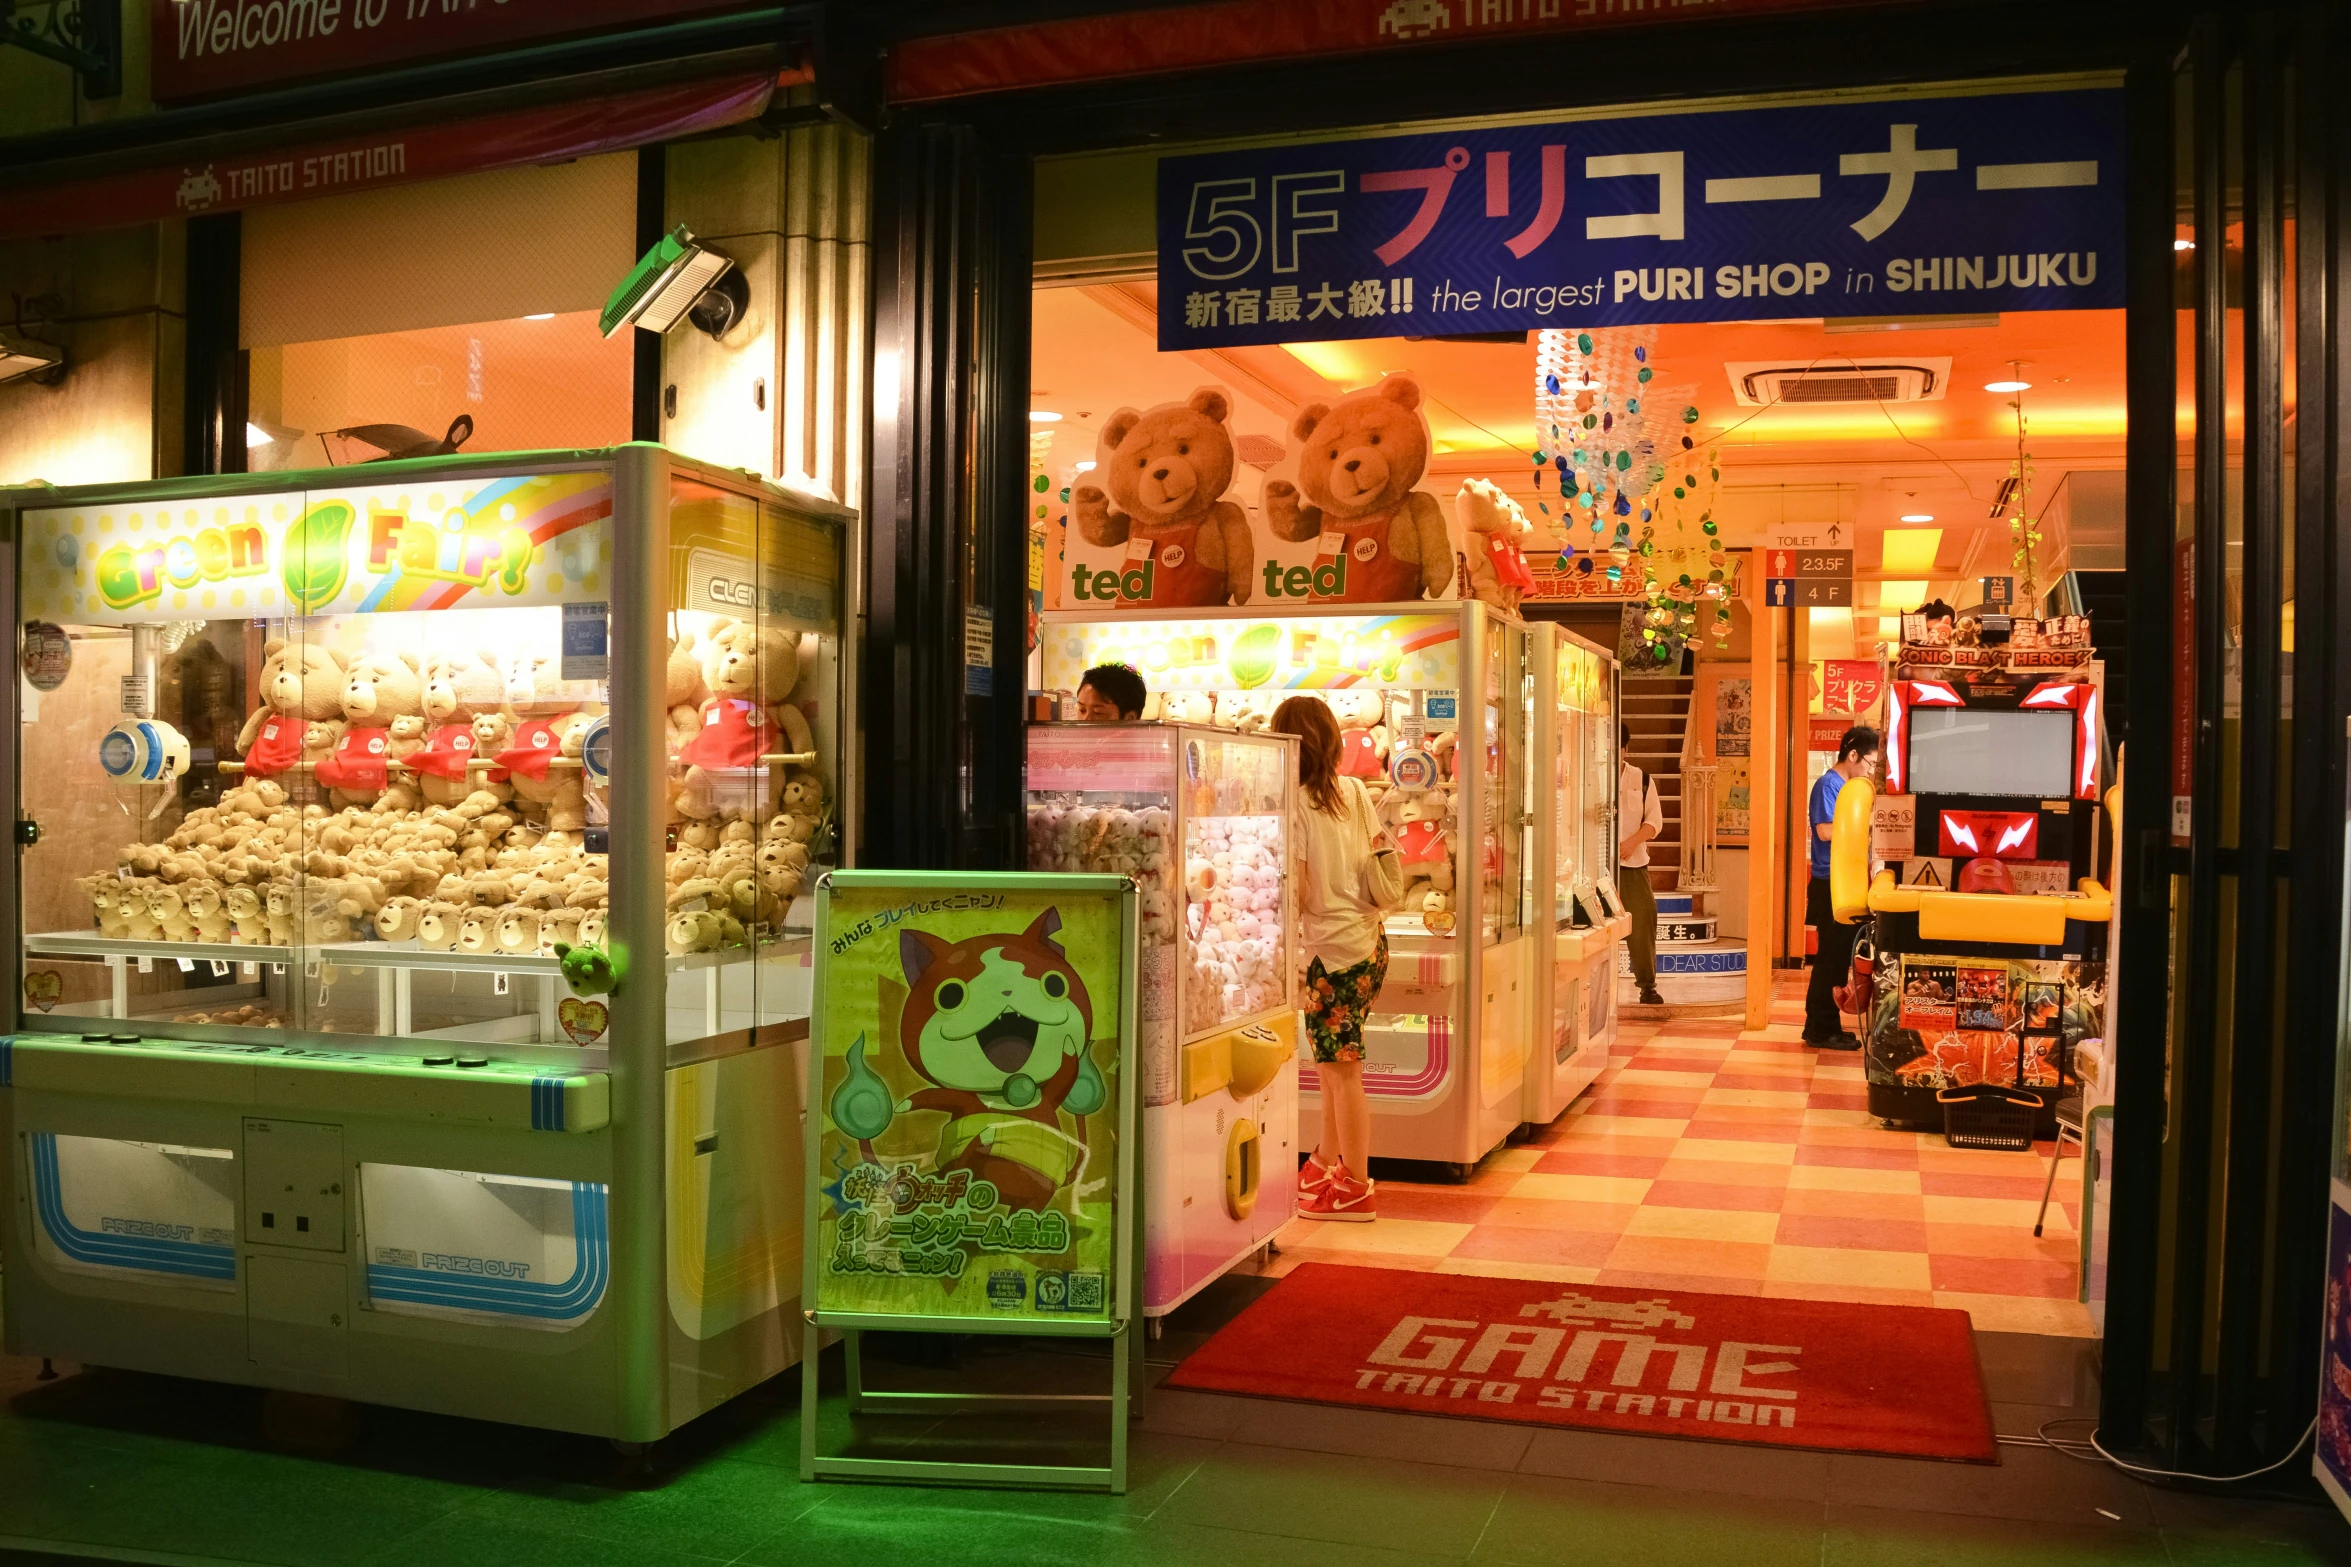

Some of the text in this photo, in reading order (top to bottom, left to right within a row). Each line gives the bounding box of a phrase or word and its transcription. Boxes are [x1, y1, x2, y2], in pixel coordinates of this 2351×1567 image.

[178, 0, 340, 60] Welcome
[354, 0, 388, 30] to
[227, 143, 406, 199] TAITO STATION
[1184, 251, 2097, 329] 新宿最大級!! the largest PURI SHOP in SHINJUKU
[1356, 543, 1376, 557] HELP
[1777, 536, 1818, 546] TOILET
[97, 507, 532, 608] Green Fair!
[1164, 550, 1183, 563] HELP
[1802, 557, 1845, 571] 2.3.5F
[1071, 559, 1155, 601] ted
[1262, 553, 1347, 597] ted
[1827, 664, 1844, 677] 5F
[1898, 648, 2092, 672] SONIC BLAST HEROES
[1814, 730, 1842, 740] PRIZE
[1662, 955, 1706, 972] DEAR
[1366, 1063, 1397, 1074] OUT
[101, 1217, 154, 1237] PRIZE
[155, 1223, 194, 1241] OUT
[840, 1210, 1066, 1250] クレーンゲーム景品
[422, 1252, 483, 1274] PRIZE
[485, 1260, 530, 1279] OUT
[1366, 1315, 1802, 1400] GAME
[1355, 1368, 1796, 1428] TAITO STATION
